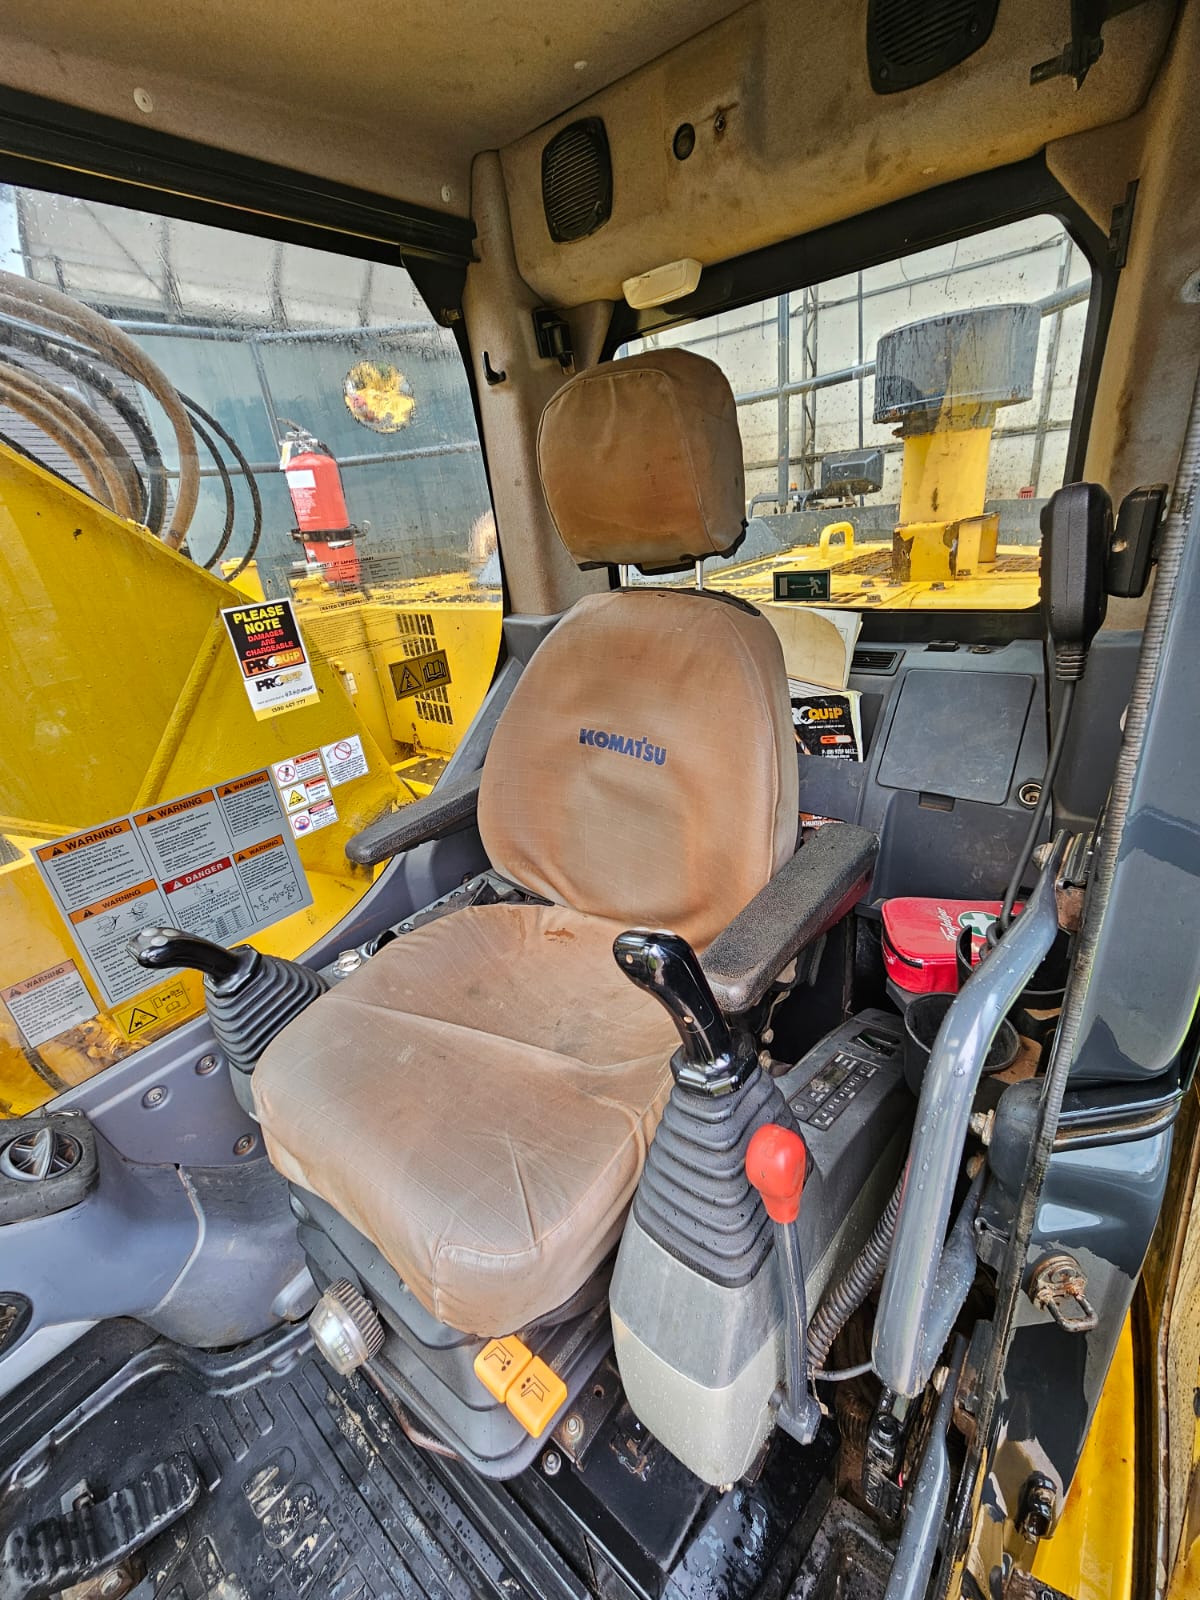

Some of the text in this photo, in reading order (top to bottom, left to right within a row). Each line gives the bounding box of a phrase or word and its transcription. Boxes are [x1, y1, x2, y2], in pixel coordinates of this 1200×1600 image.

[232, 603, 284, 625] PLEASE
[244, 616, 281, 634] NOTE
[247, 628, 283, 642] DAMAGES
[245, 640, 294, 657] CHARGEABLE
[260, 637, 275, 646] ARE
[579, 727, 667, 766] KOMATSU
[232, 775, 264, 790] WARNING
[157, 796, 202, 817] WARNING
[64, 824, 123, 850] WARNING
[248, 838, 278, 855] WARNING
[184, 862, 223, 883] DANGER
[101, 888, 141, 909] WARNING
[23, 966, 65, 989] WARNING
